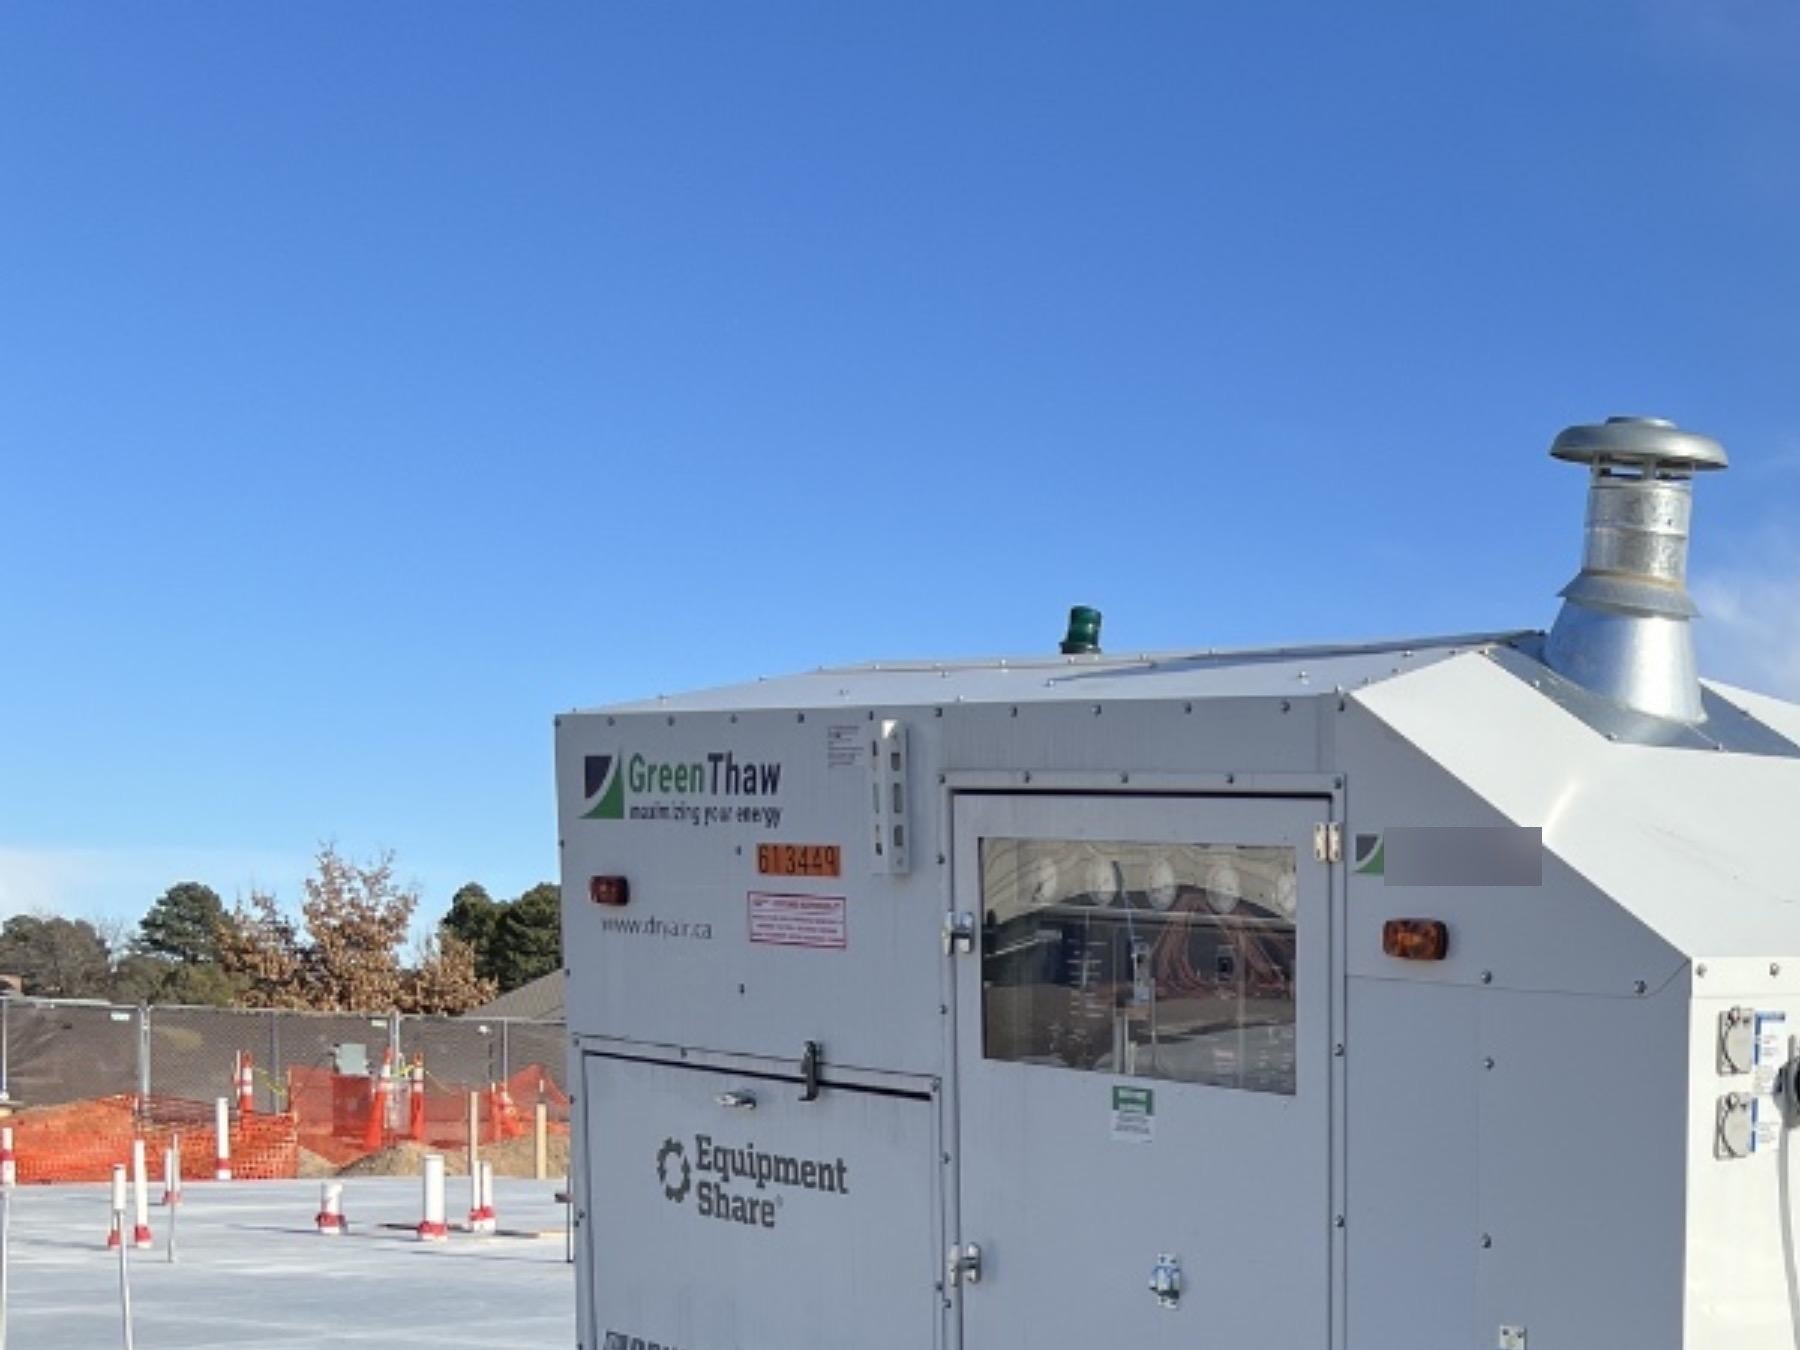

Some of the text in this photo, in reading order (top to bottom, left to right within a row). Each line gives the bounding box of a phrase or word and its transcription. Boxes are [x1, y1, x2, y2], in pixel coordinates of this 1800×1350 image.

[629, 752, 782, 796] GreenThaw
[629, 802, 783, 829] maximizing your energy
[758, 844, 836, 875] 613449
[695, 1134, 849, 1195] Equipment
